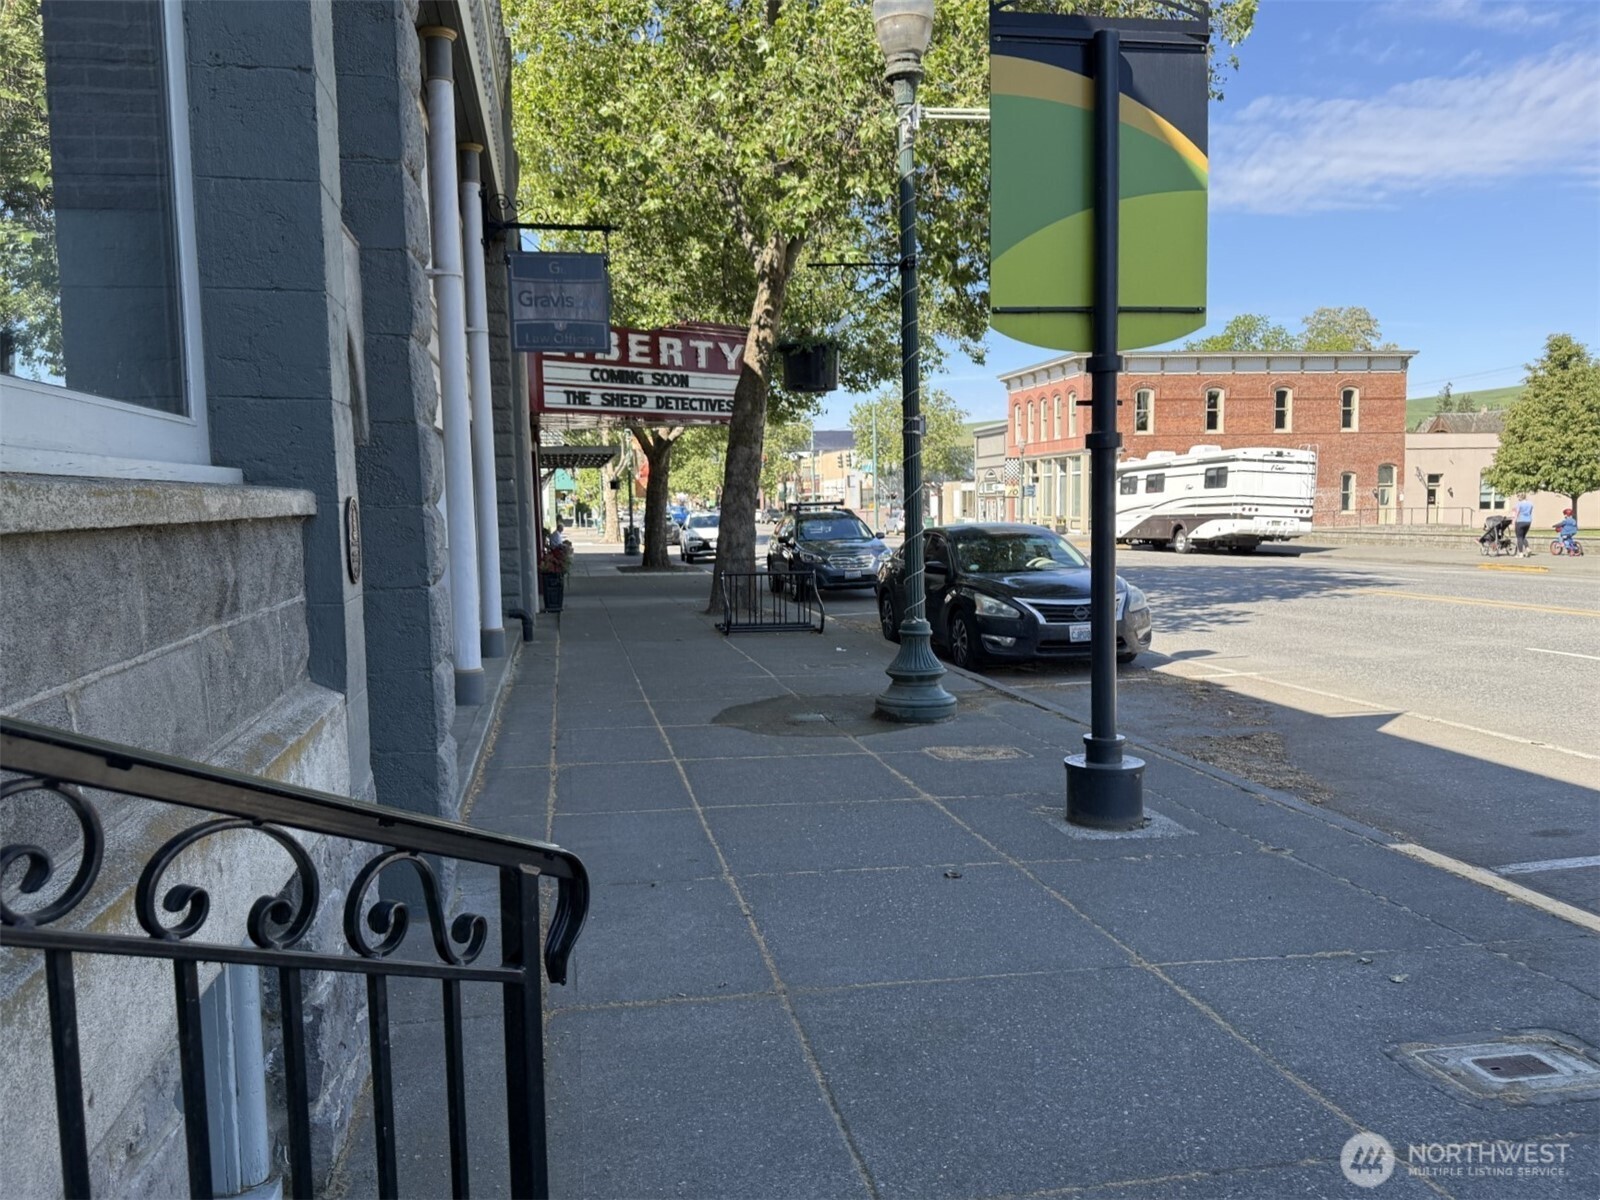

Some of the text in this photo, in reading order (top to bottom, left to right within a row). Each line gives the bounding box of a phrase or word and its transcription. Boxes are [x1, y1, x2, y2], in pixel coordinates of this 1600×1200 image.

[518, 290, 575, 308] Gravis
[542, 332, 744, 371] BERTY
[590, 367, 689, 388] COMING SOON
[563, 390, 735, 412] THE SHEEP DETECTIVES
